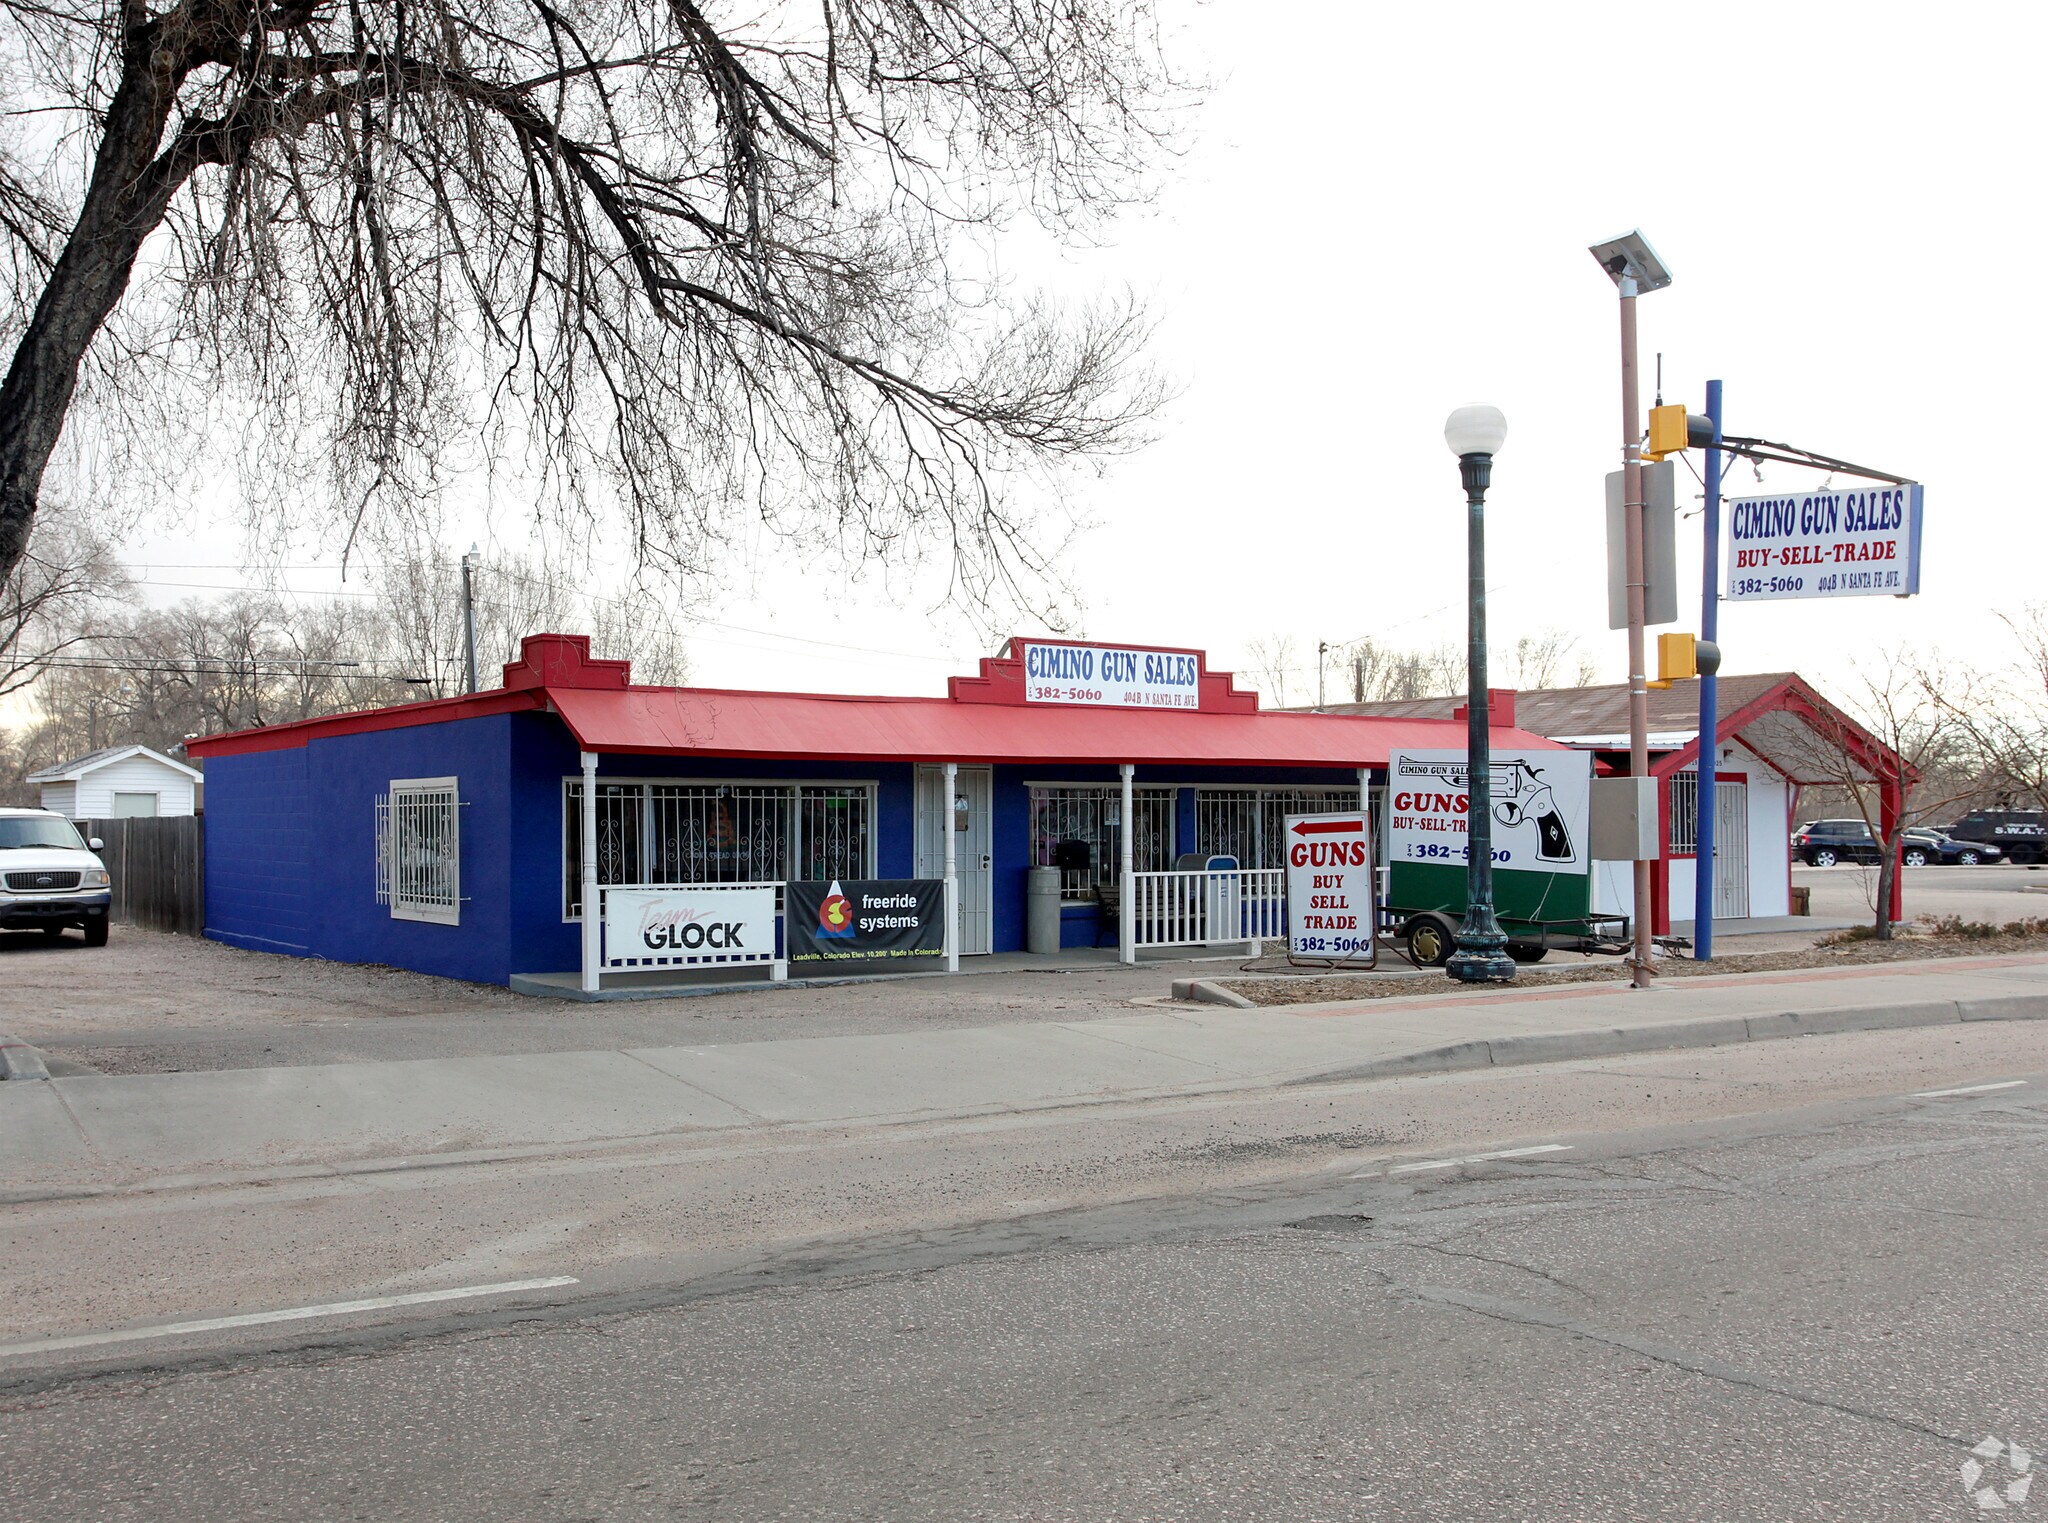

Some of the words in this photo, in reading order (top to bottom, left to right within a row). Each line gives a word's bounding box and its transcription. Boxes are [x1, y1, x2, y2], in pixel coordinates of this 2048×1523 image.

[1733, 498, 1796, 540] CIMINO
[1801, 495, 1840, 535] GUN
[1844, 490, 1903, 532] SALES
[1736, 540, 1897, 569] BUY-SELL-TRADE
[1738, 577, 1803, 595] 382-5060
[1818, 574, 1837, 592] 404B
[1841, 573, 1847, 589] N
[1849, 572, 1871, 589] SANTA
[1873, 571, 1883, 588] FE
[1885, 570, 1900, 587] AVE.
[1028, 646, 1094, 681] CIMINO
[1101, 651, 1137, 683] GUN
[1144, 655, 1196, 687] SALES
[1035, 686, 1102, 701] 382-5060
[1124, 691, 1142, 704] 404B
[1145, 693, 1150, 704] N
[1152, 693, 1172, 706] SANTA
[1174, 694, 1182, 706] FE
[1184, 695, 1197, 707] AVE.
[1400, 765, 1428, 775] CIMINO
[1430, 766, 1448, 775] GUN
[1450, 767, 1469, 775] SAL
[1394, 792, 1469, 814] GUNS
[1393, 817, 1469, 833] BUY-SELL-TR
[1994, 826, 2047, 835] S.W.A.T.
[1290, 841, 1366, 867] GUNS
[1416, 844, 1511, 862] 382-560
[1312, 875, 1344, 888] BUY
[862, 893, 917, 909] freeride
[1310, 896, 1349, 909] SELL
[638, 899, 716, 936] Team
[859, 914, 919, 932] systems
[1303, 916, 1357, 929] TRADE
[644, 922, 744, 949] GLOCK
[1300, 937, 1369, 952] 382-5060
[793, 953, 823, 961] Leadville,
[823, 951, 851, 959] Colorado
[851, 950, 866, 959] Elev.
[890, 949, 907, 957] Made
